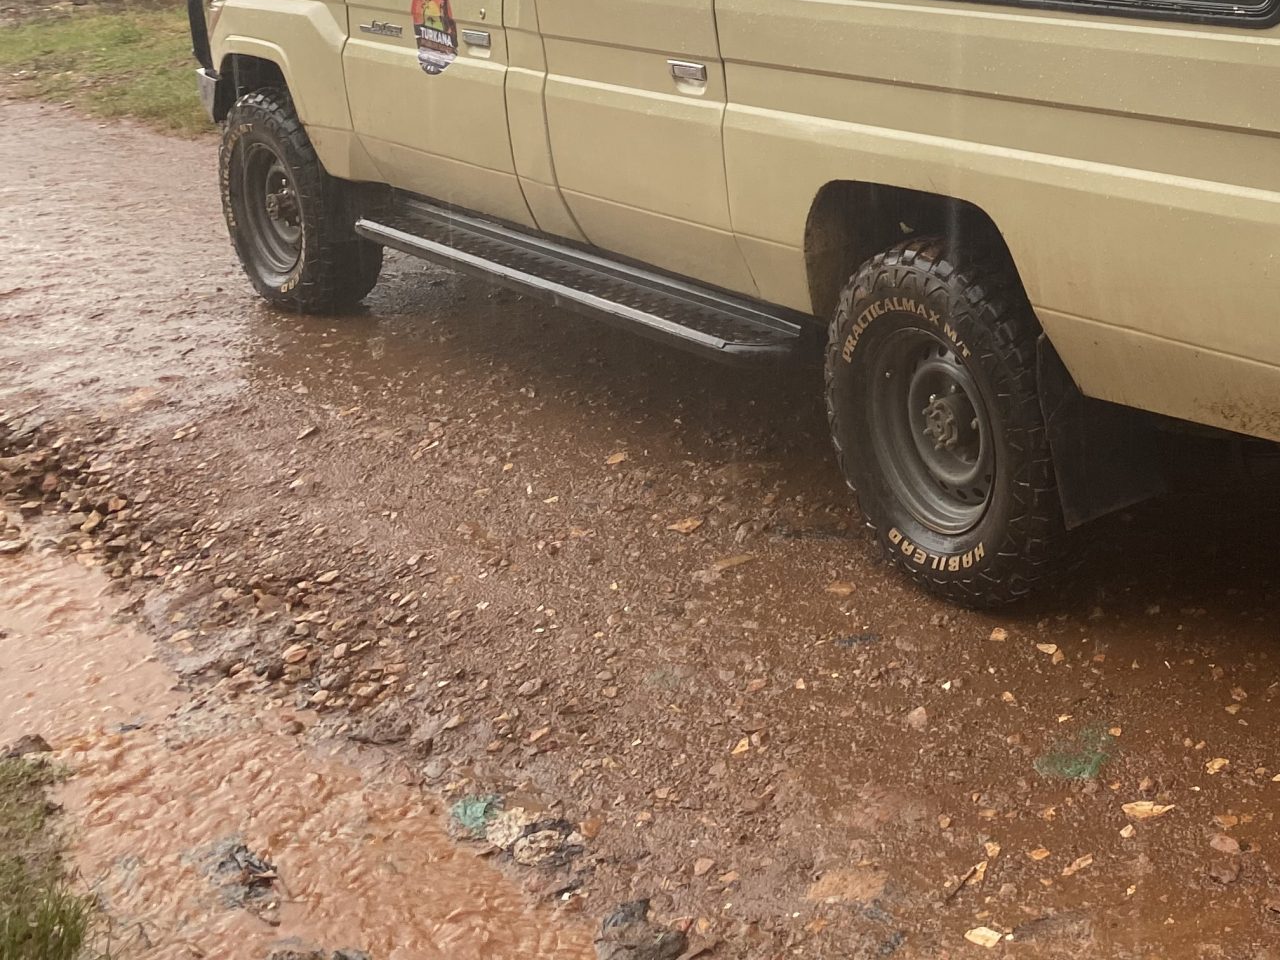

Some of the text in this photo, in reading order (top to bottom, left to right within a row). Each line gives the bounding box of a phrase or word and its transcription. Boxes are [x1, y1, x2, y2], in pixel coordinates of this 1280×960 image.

[419, 26, 454, 48] TURKANA
[841, 297, 972, 363] PRACTICALMAX M/T
[888, 527, 985, 572] HABILEAD
